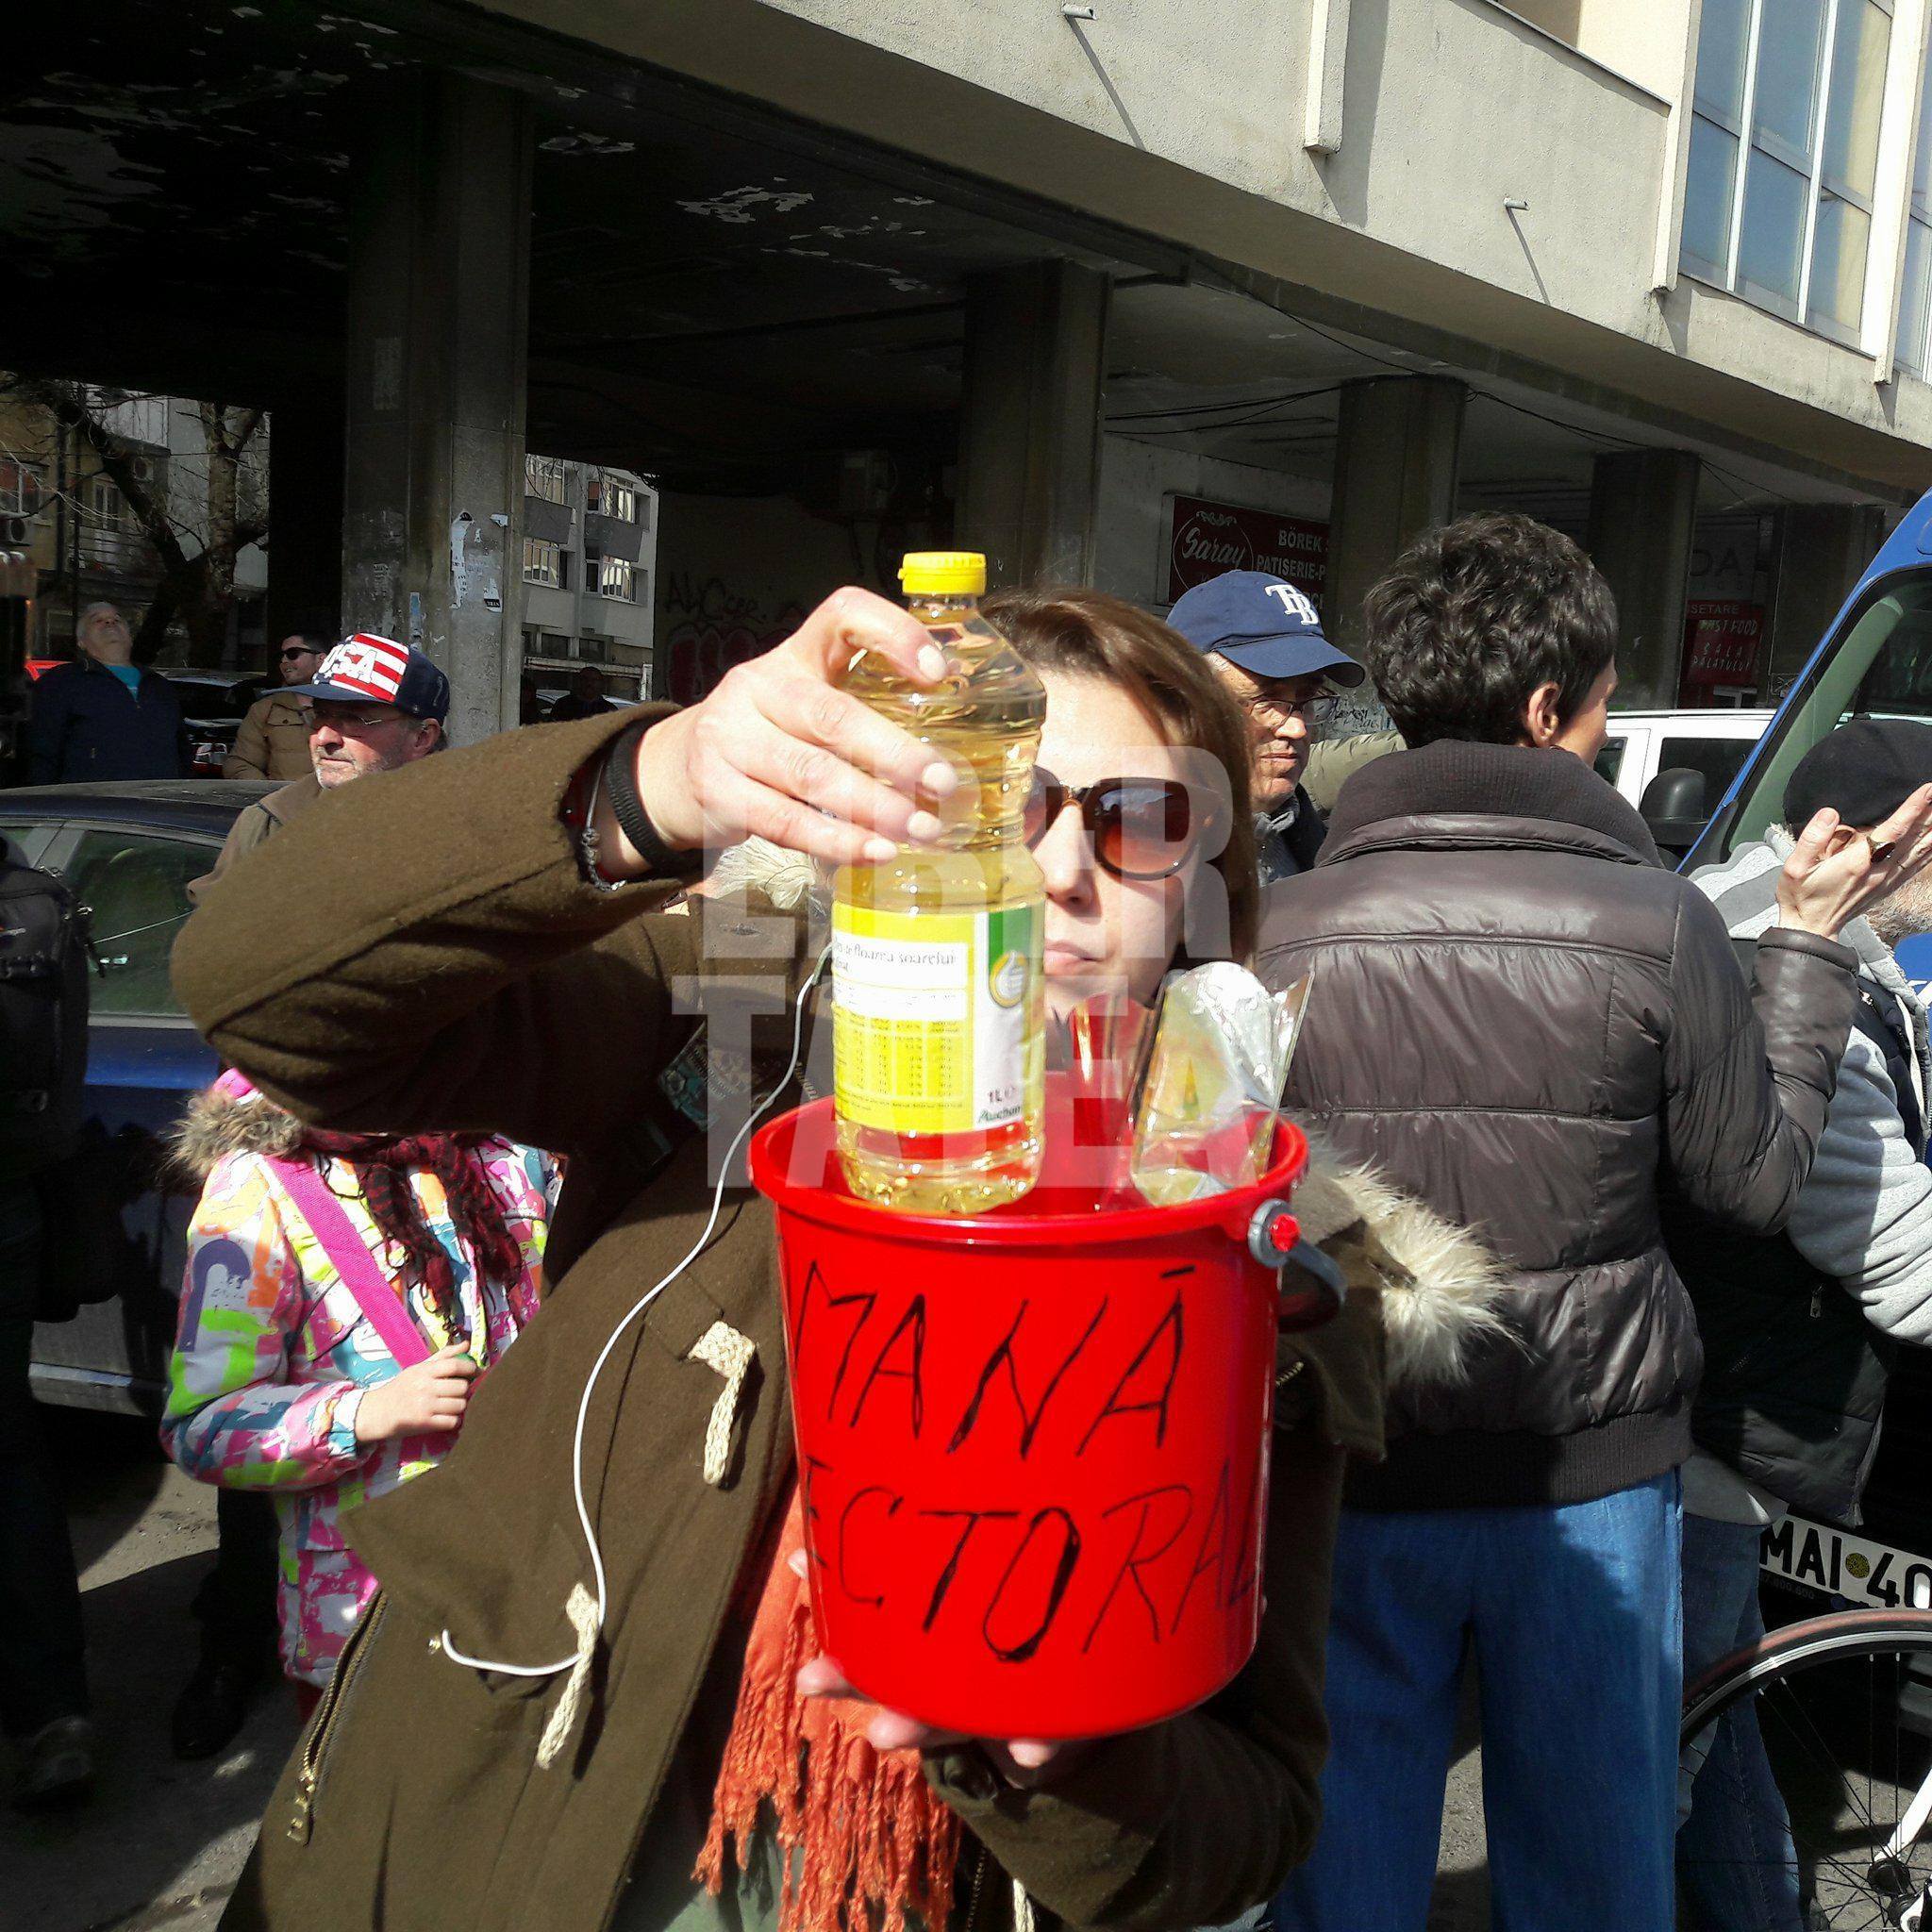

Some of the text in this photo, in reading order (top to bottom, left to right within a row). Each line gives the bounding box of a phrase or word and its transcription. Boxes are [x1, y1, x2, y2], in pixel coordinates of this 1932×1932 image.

[1182, 525, 1246, 571] Saray
[1277, 525, 1323, 552] BÖREK
[318, 642, 378, 685] USA
[1759, 1520, 1842, 1591] MAI
